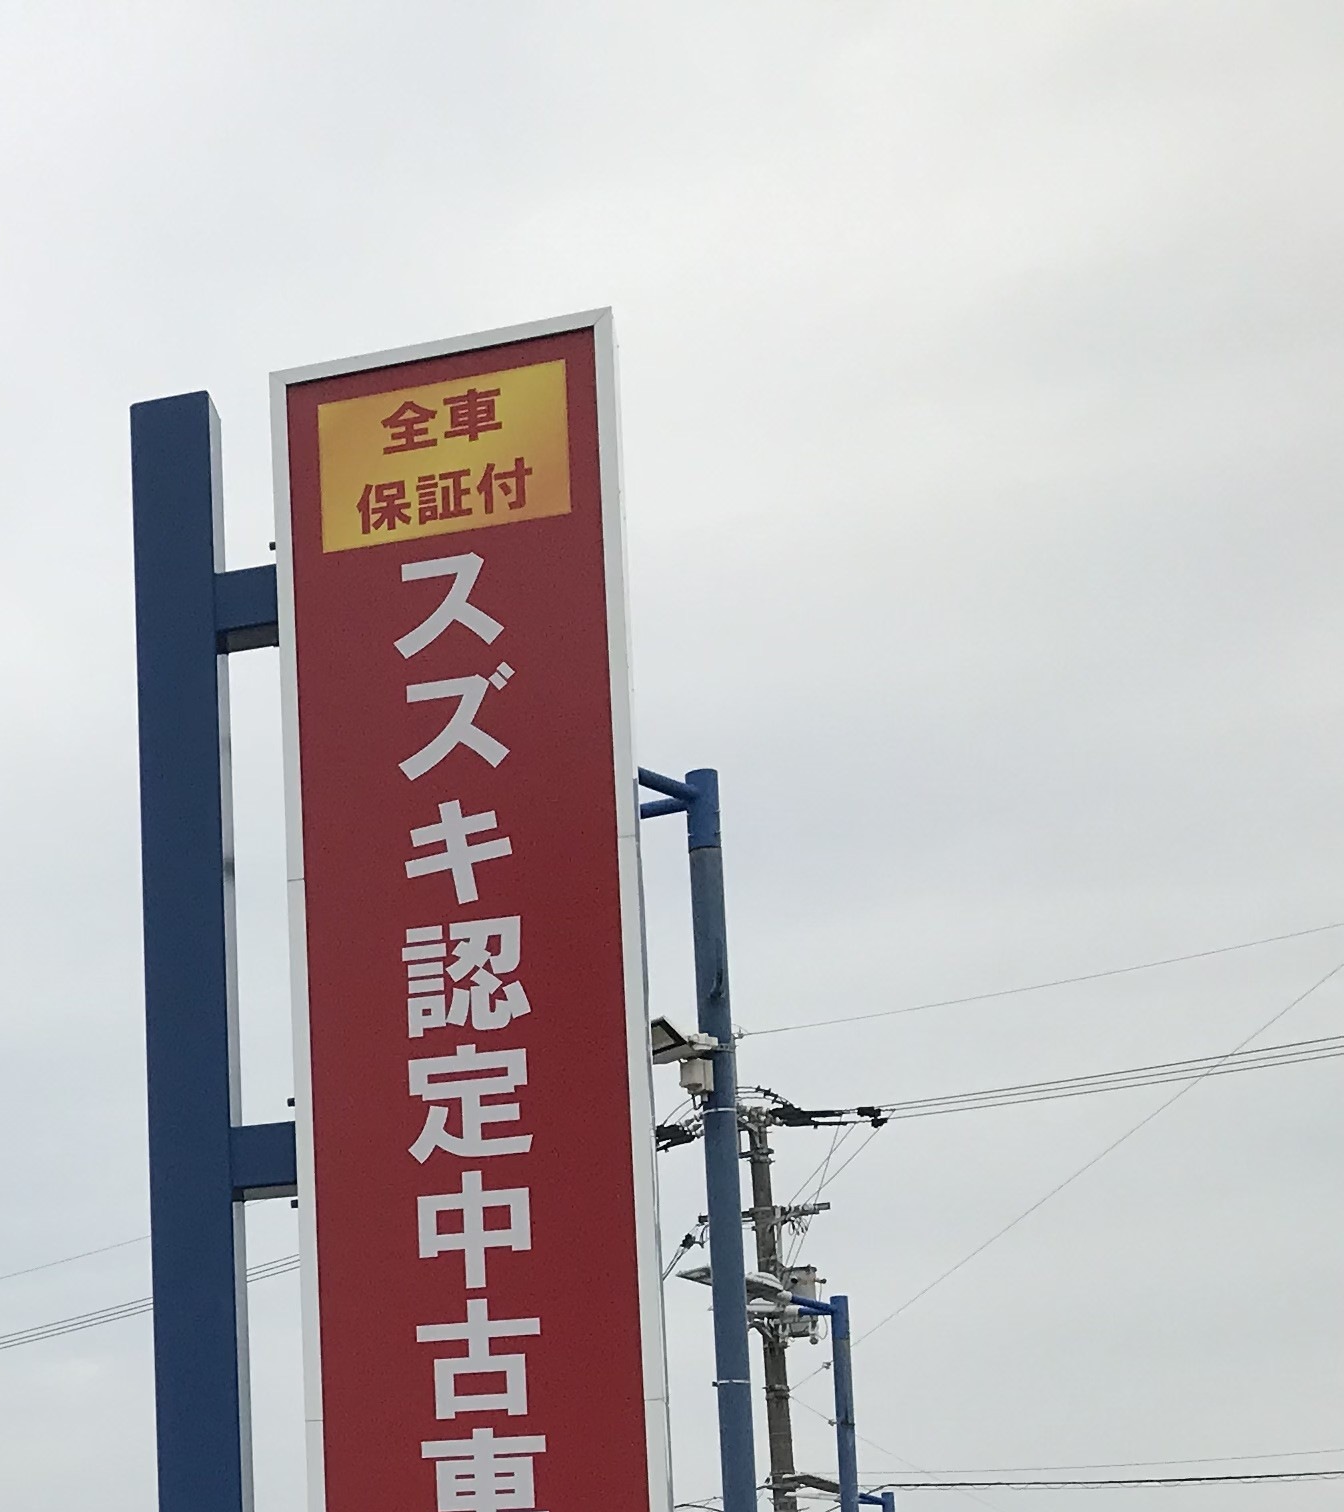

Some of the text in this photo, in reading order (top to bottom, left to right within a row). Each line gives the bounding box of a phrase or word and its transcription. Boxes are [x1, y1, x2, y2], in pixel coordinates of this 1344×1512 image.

[381, 388, 503, 455] 全車
[356, 457, 533, 534] 保証付
